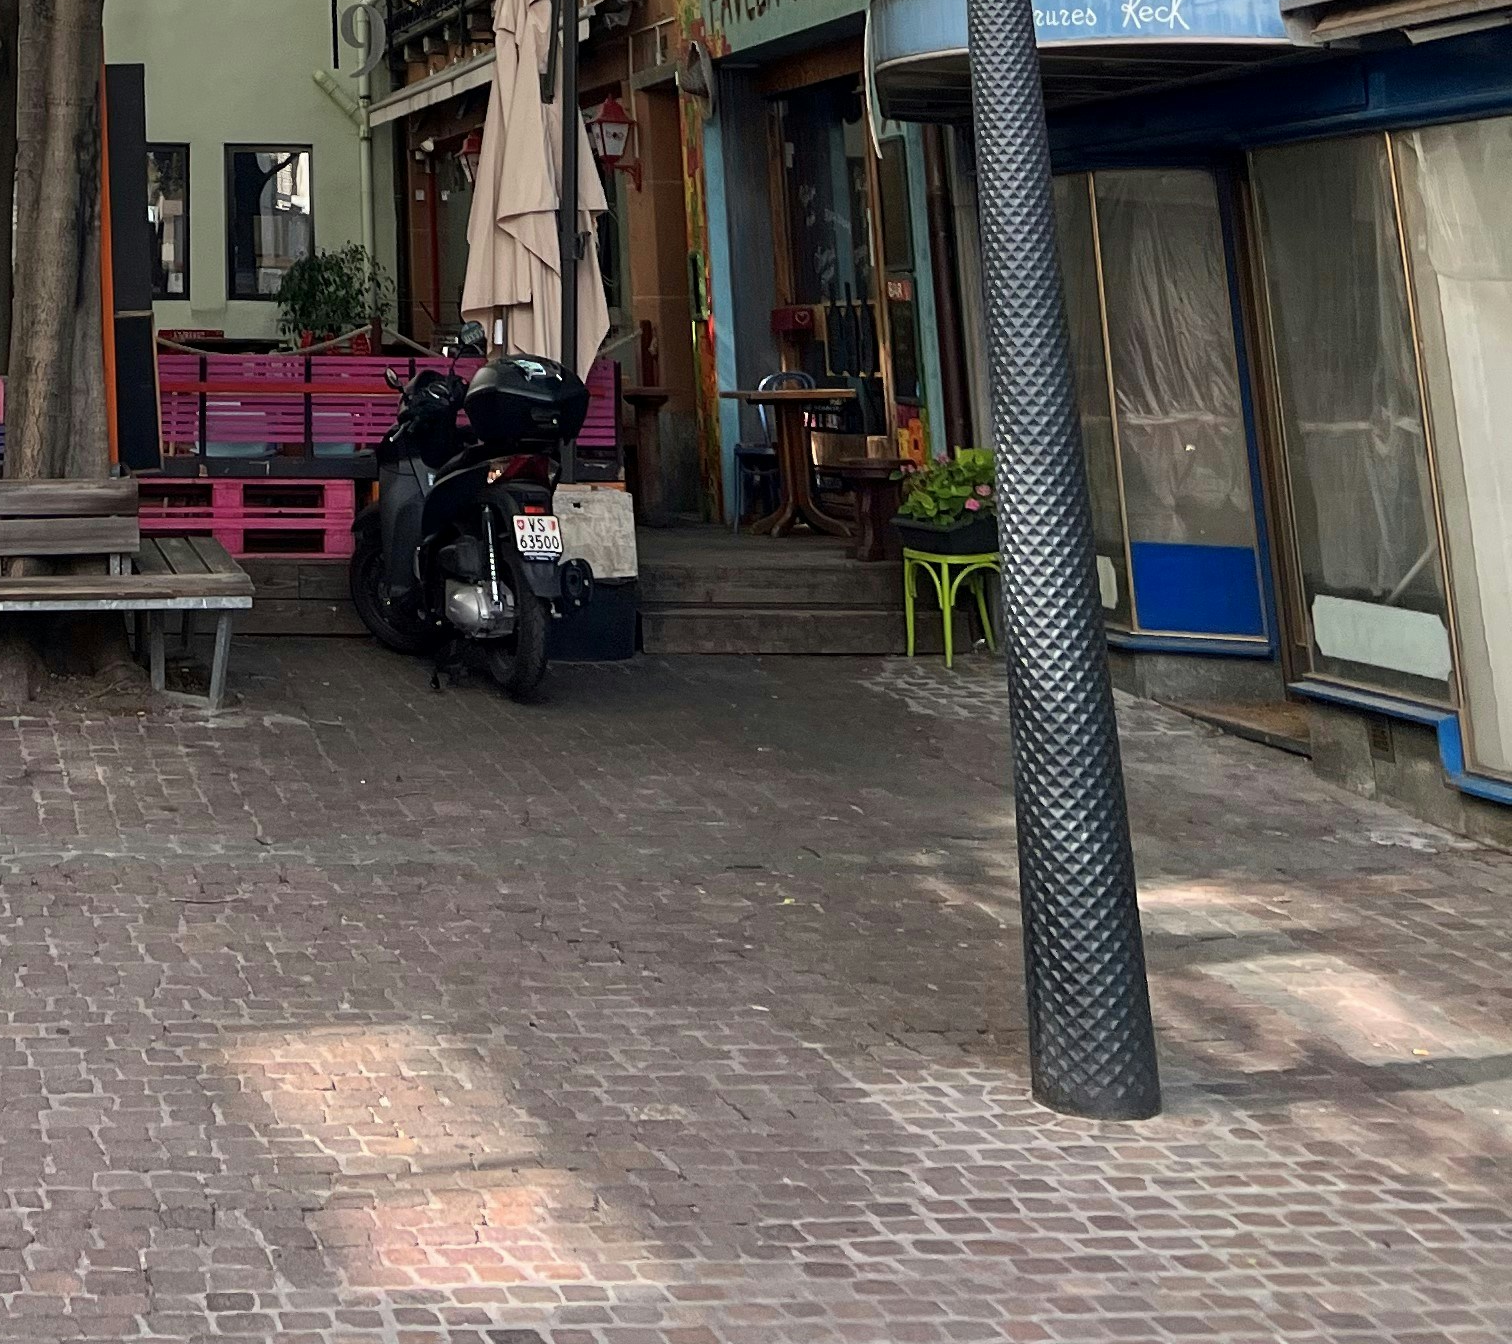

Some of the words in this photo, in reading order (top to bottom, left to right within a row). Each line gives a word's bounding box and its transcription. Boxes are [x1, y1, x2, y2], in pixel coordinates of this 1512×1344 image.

[1033, 7, 1097, 27] rures
[528, 518, 545, 532] VS
[520, 535, 559, 549] 63500
